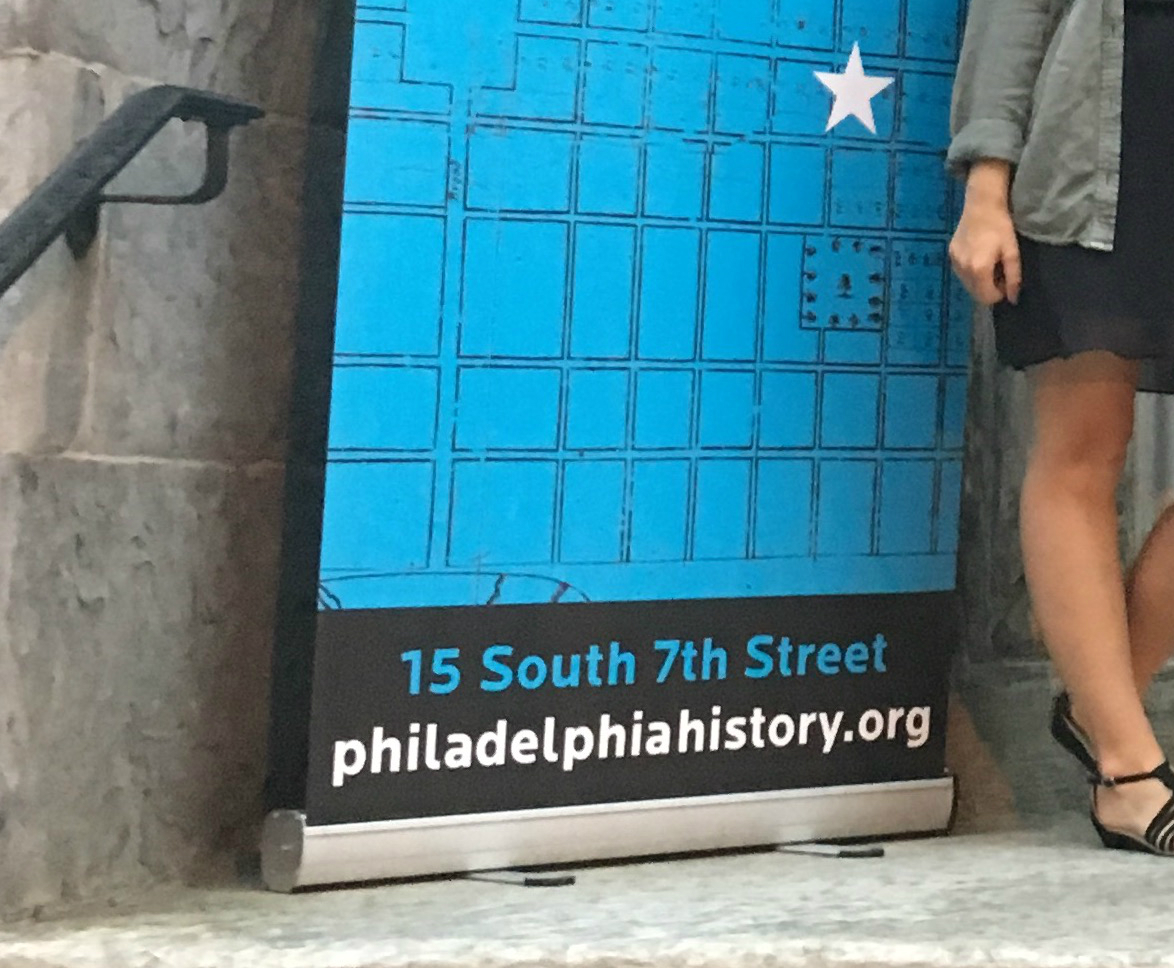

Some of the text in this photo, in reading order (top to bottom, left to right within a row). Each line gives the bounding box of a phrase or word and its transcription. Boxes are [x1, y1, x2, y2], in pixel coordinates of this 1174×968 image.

[400, 633, 888, 695] 15 South 7th Street
[330, 704, 932, 788] philadelphiahistory.org
